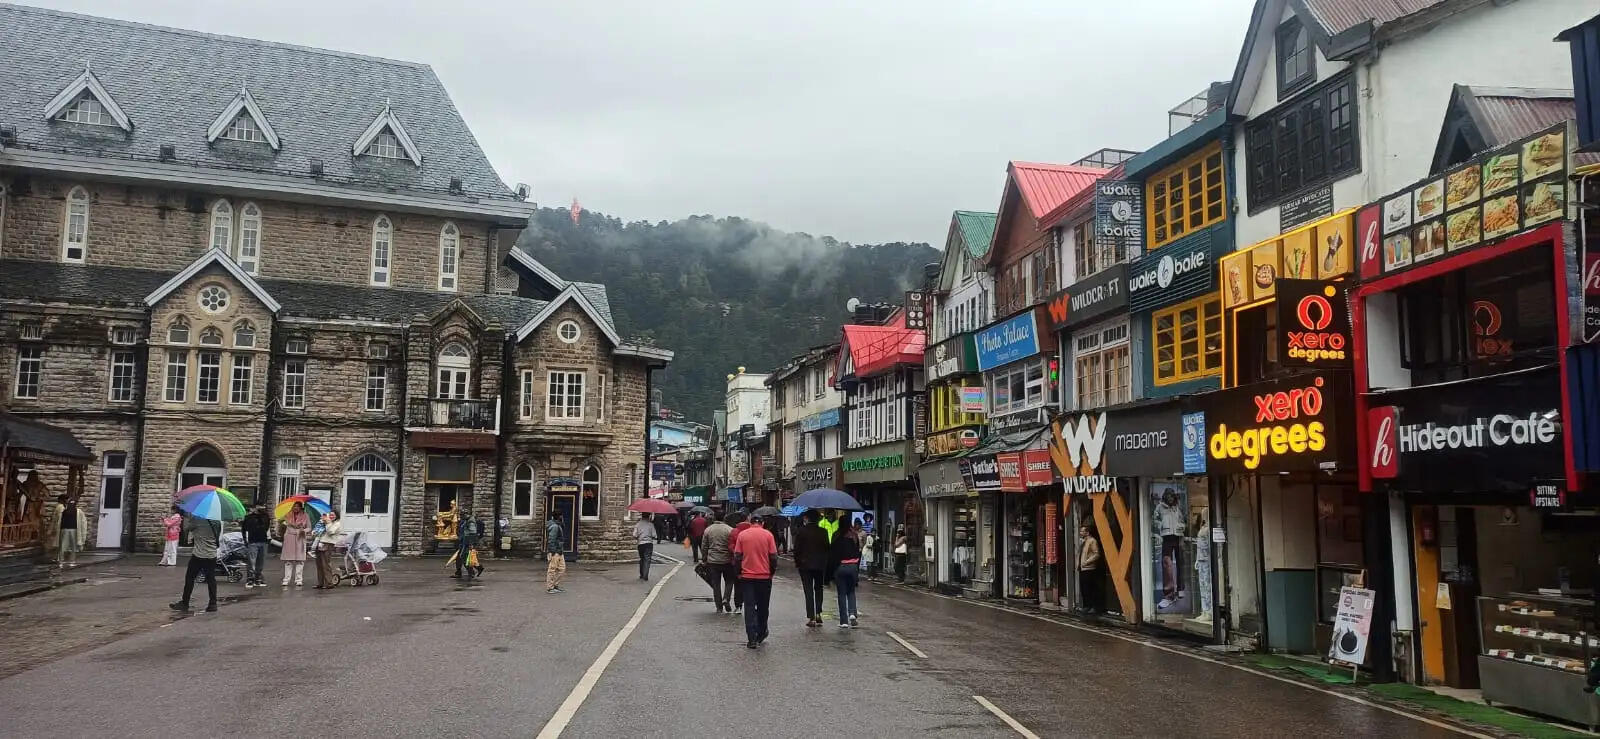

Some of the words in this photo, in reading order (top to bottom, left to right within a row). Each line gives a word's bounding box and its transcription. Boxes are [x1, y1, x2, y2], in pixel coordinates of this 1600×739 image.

[1103, 185, 1141, 196] wake
[1104, 225, 1141, 238] bake
[1362, 220, 1378, 263] h
[1129, 270, 1157, 292] wake
[1174, 251, 1204, 275] bake
[1071, 278, 1119, 312] WILDCRFT
[1002, 320, 1031, 346] Palace
[1288, 331, 1345, 350] xero
[1288, 346, 1345, 362] degrees
[1254, 386, 1322, 423] xero
[1399, 417, 1486, 453] Hideout
[1489, 408, 1559, 446] Café
[1210, 421, 1326, 470] degrees
[800, 467, 832, 481] OCTAVE
[1027, 462, 1051, 471] SHREE
[1536, 485, 1557, 495] SITTING
[1535, 497, 1560, 507] UPSTAIRS
